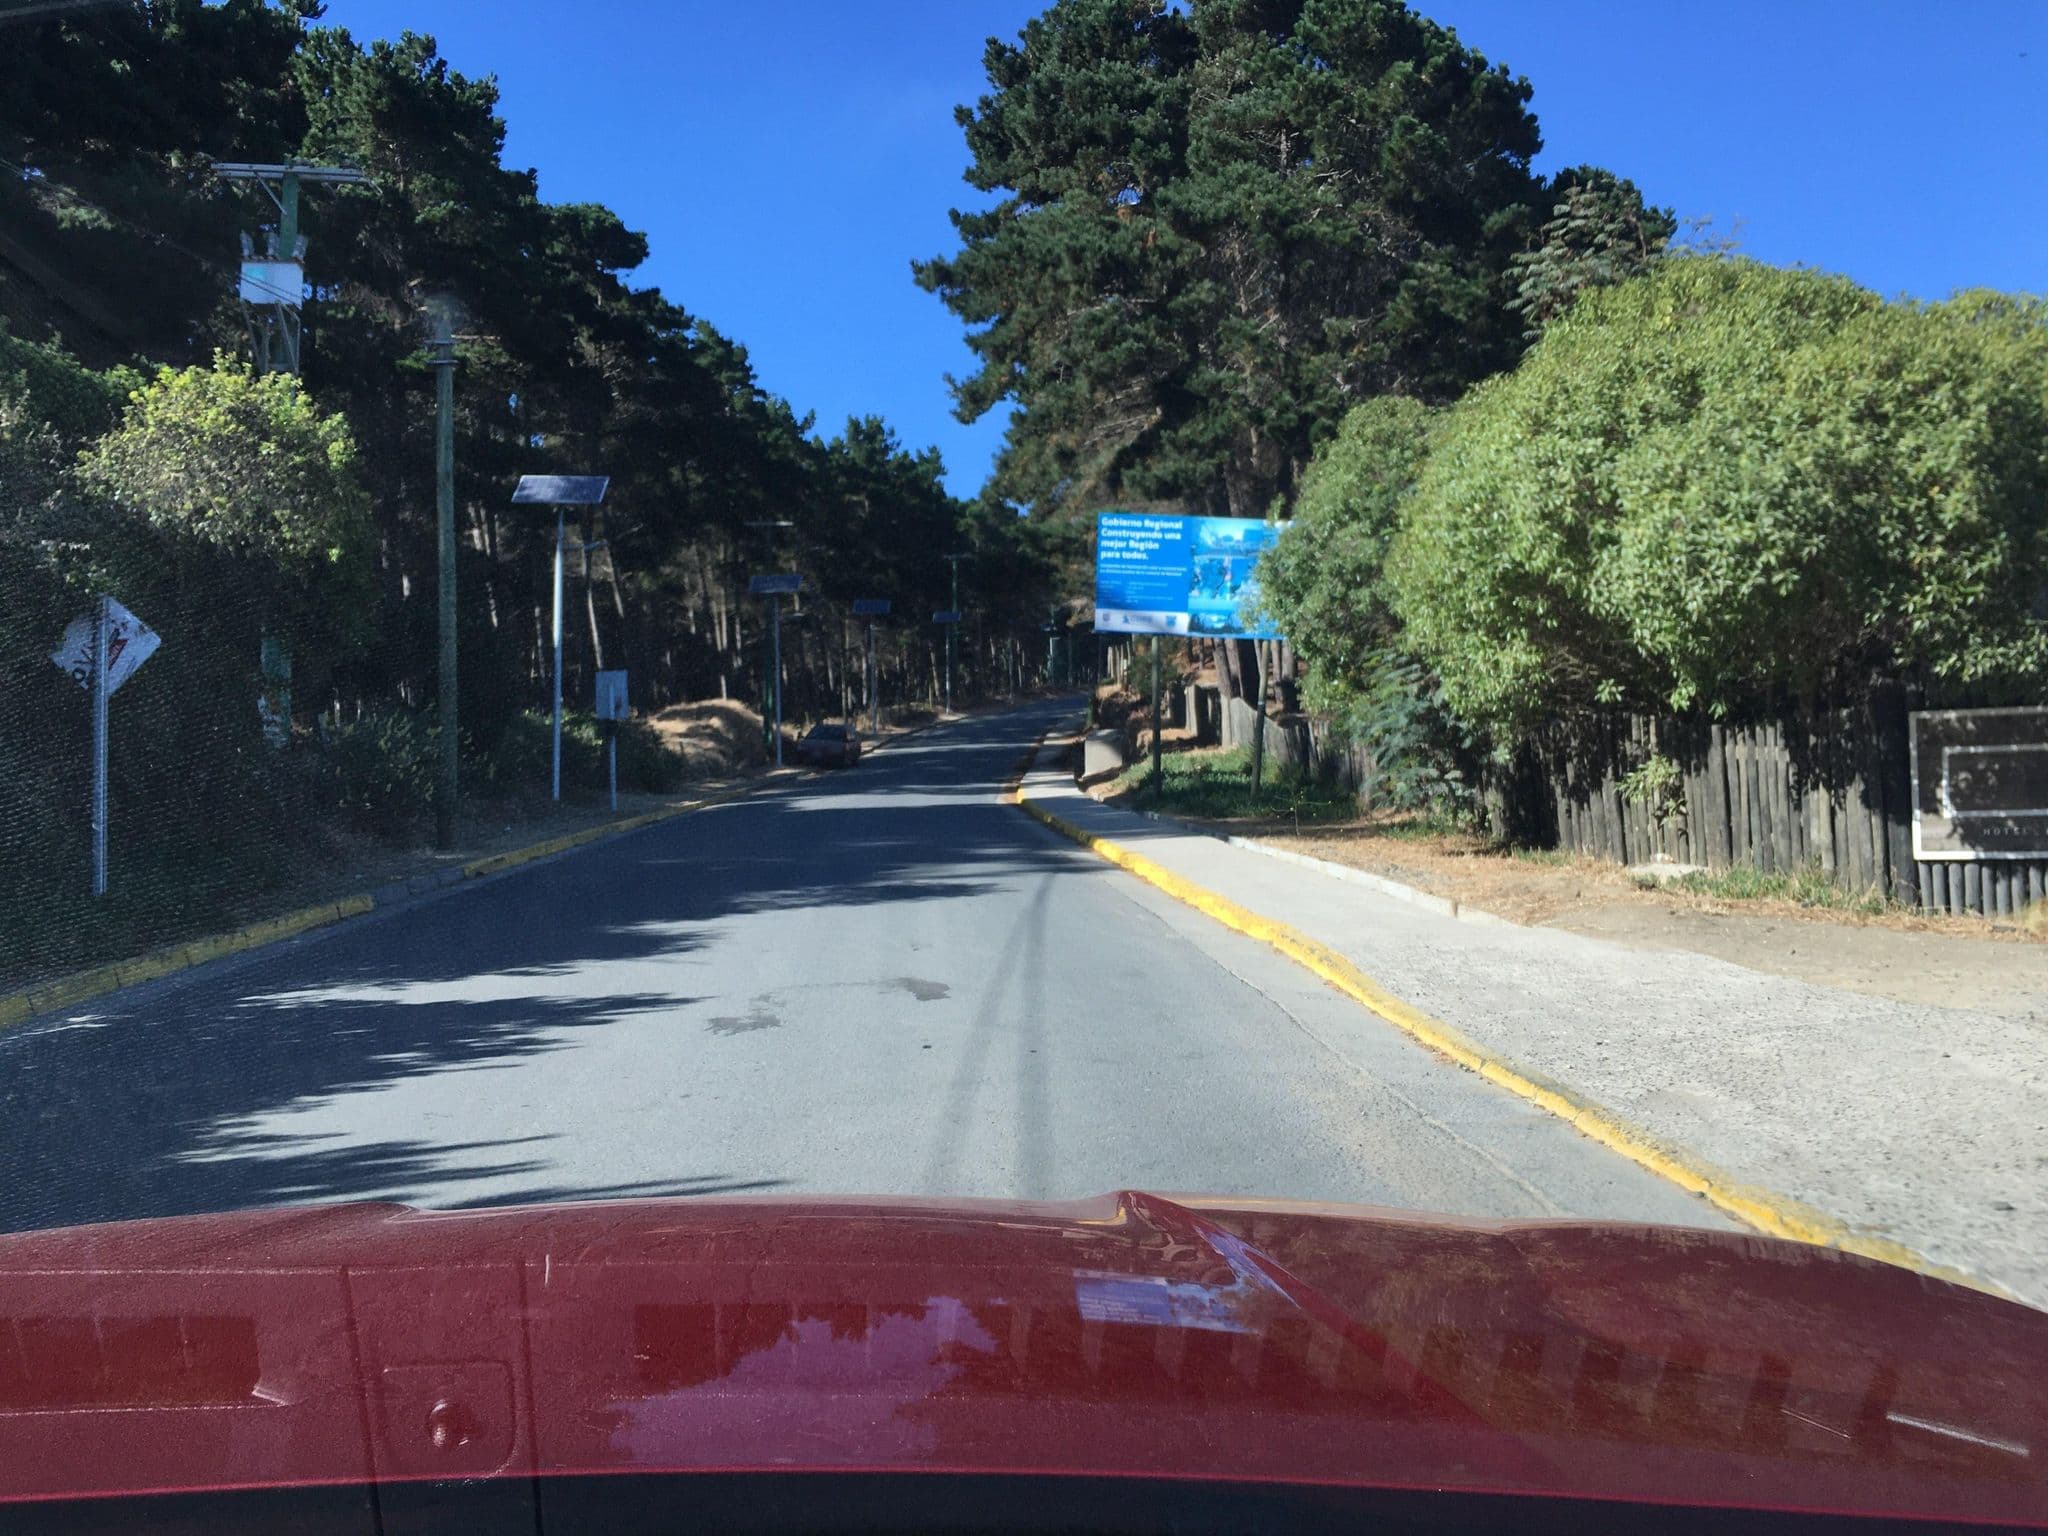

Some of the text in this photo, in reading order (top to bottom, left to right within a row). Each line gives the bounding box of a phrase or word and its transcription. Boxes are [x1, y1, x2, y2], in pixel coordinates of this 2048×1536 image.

[1101, 517, 1183, 531] Gobierno Regional
[1101, 528, 1182, 540] Construyendo una
[1101, 539, 1160, 551] mejor Región
[1100, 551, 1120, 560] para
